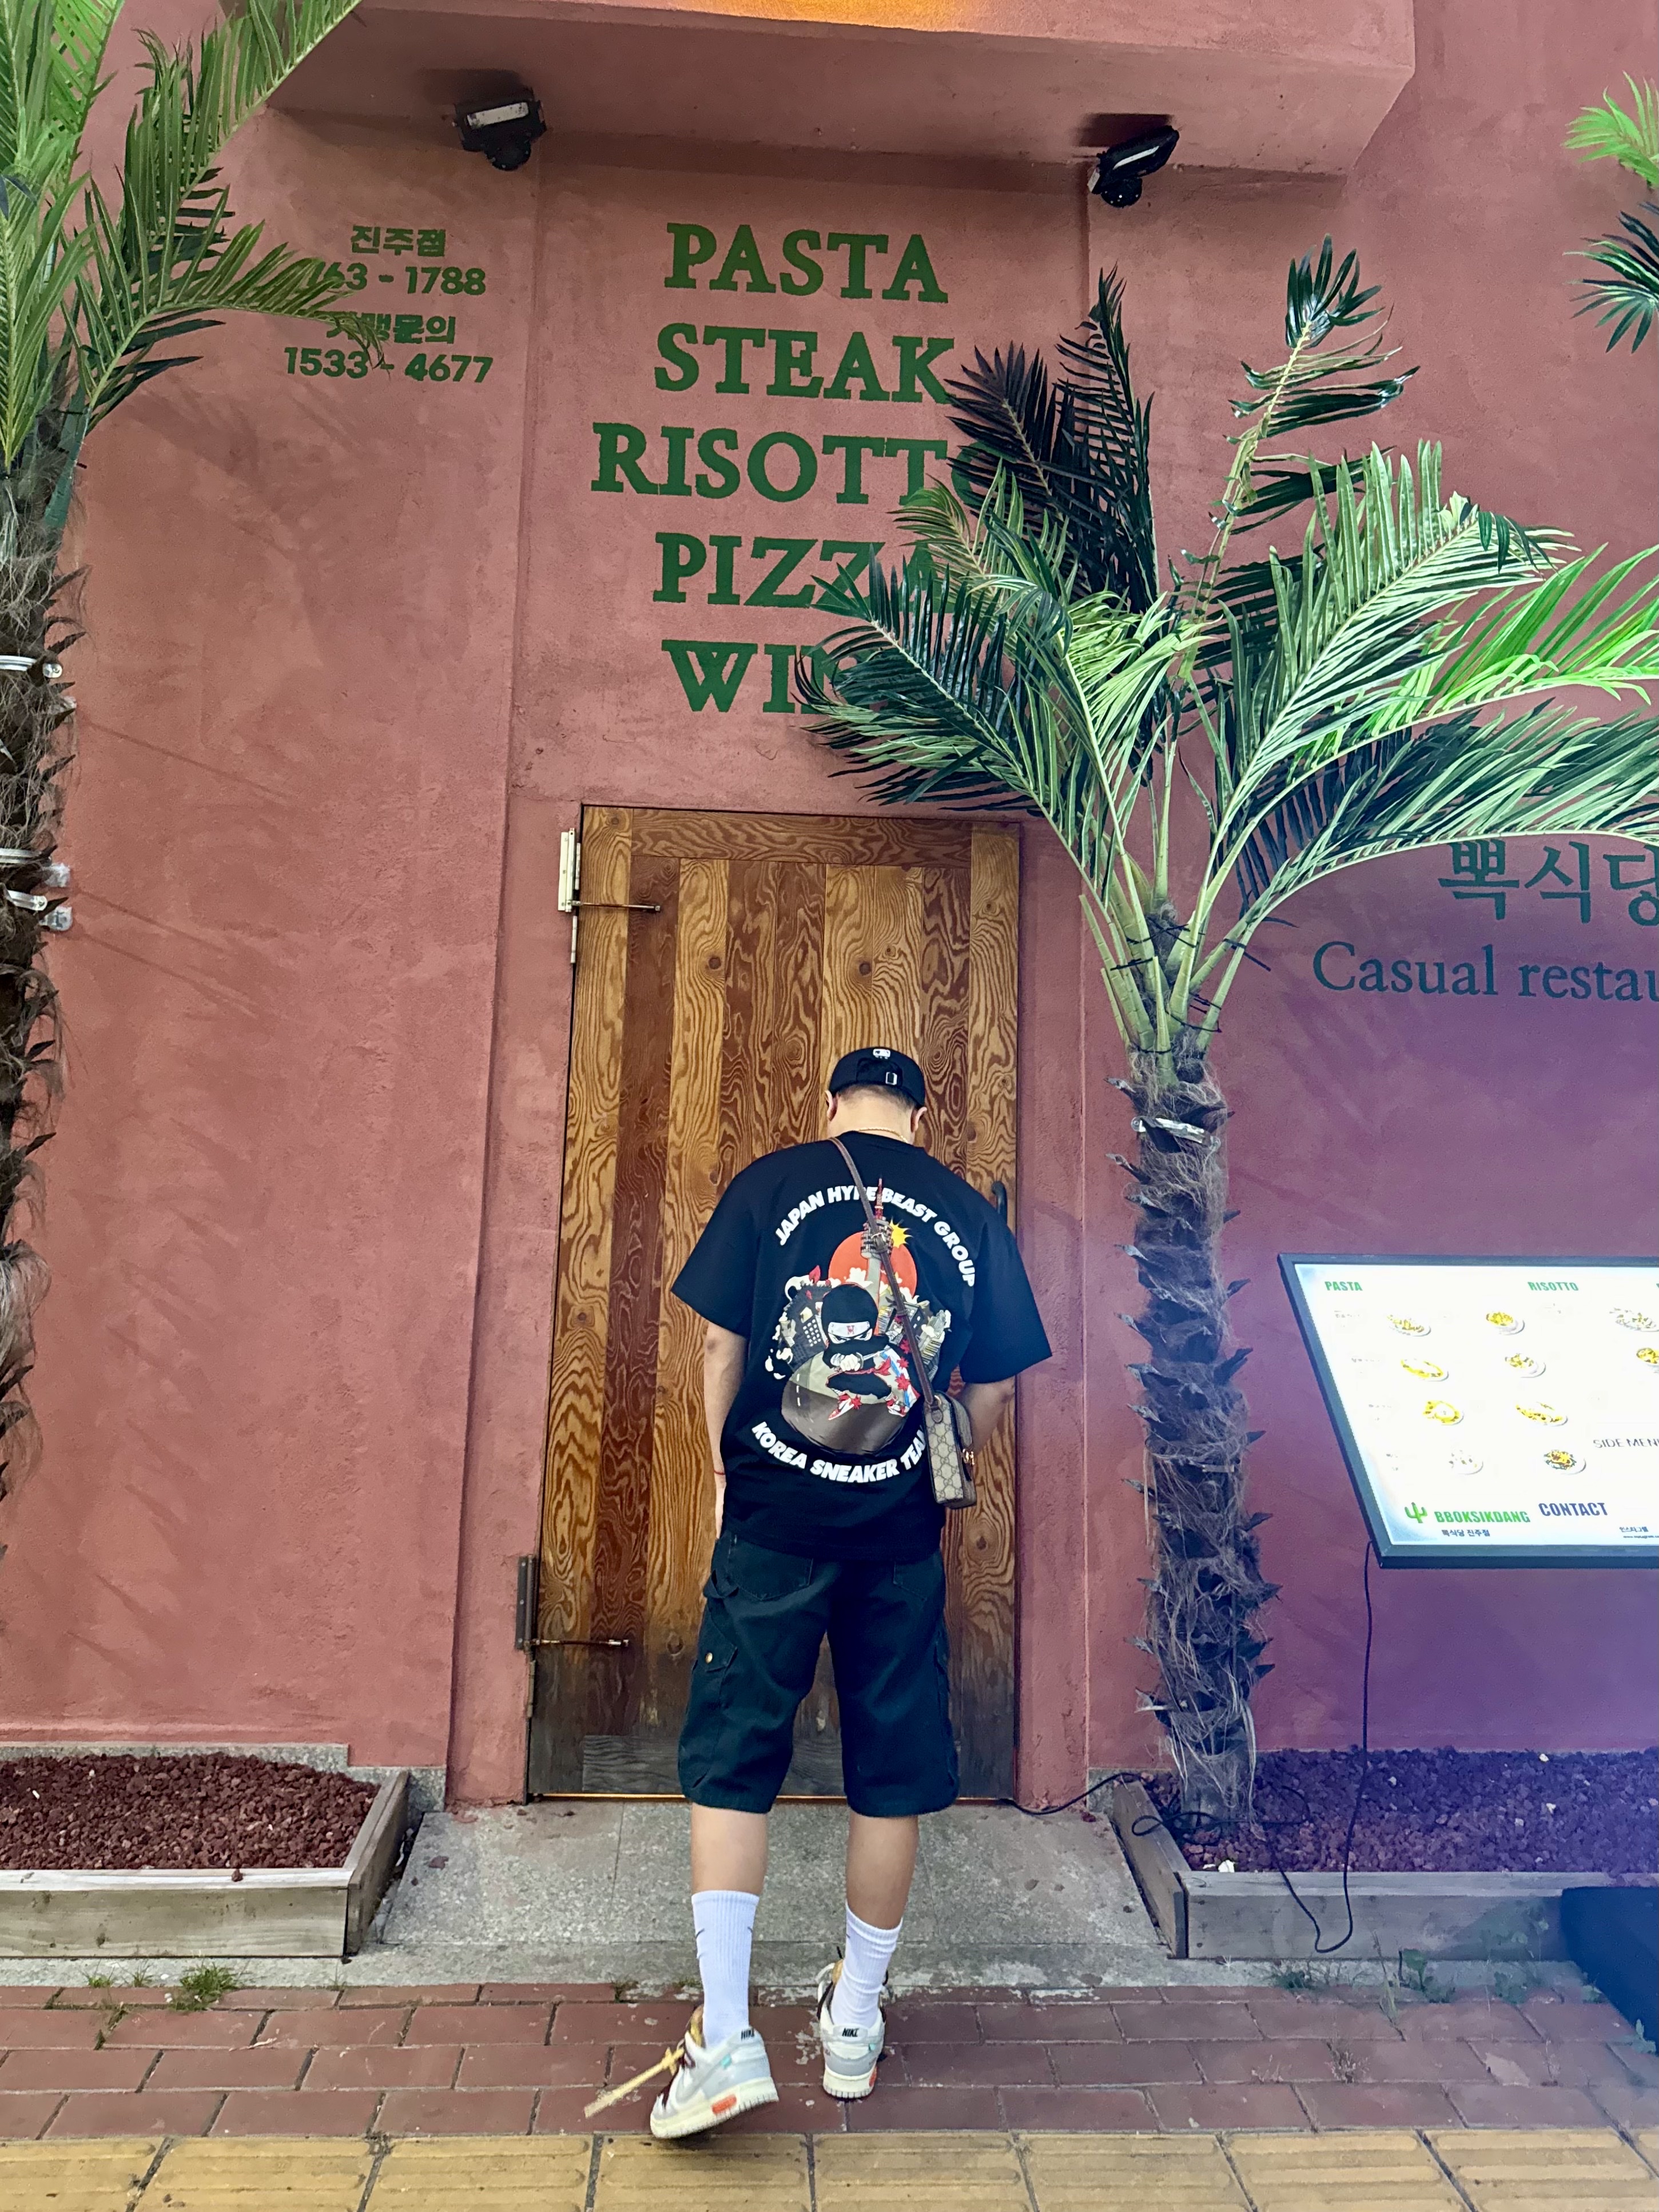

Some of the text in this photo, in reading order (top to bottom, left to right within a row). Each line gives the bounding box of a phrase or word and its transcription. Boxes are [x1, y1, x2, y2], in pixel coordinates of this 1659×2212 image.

[350, 225, 446, 257] 진주점
[664, 223, 949, 303] PASTA
[405, 265, 486, 296] 1788
[284, 346, 368, 380] 1533
[404, 352, 494, 384] 4677
[654, 323, 956, 405] STEAK
[1313, 941, 1498, 996] Casual
[775, 1191, 825, 1246] JAPAN
[882, 1187, 937, 1222] BEAST
[934, 1221, 975, 1287] GROUP
[1324, 1281, 1363, 1291] PASTA
[1527, 1282, 1579, 1291] RISOTTO
[751, 1422, 807, 1469] KOREA
[810, 1459, 900, 1483] SNEAKER
[1593, 1438, 1659, 1448] SIDE MEN
[1434, 1511, 1531, 1523] BBOKSIKDANG
[1538, 1502, 1608, 1516] CONTACT
